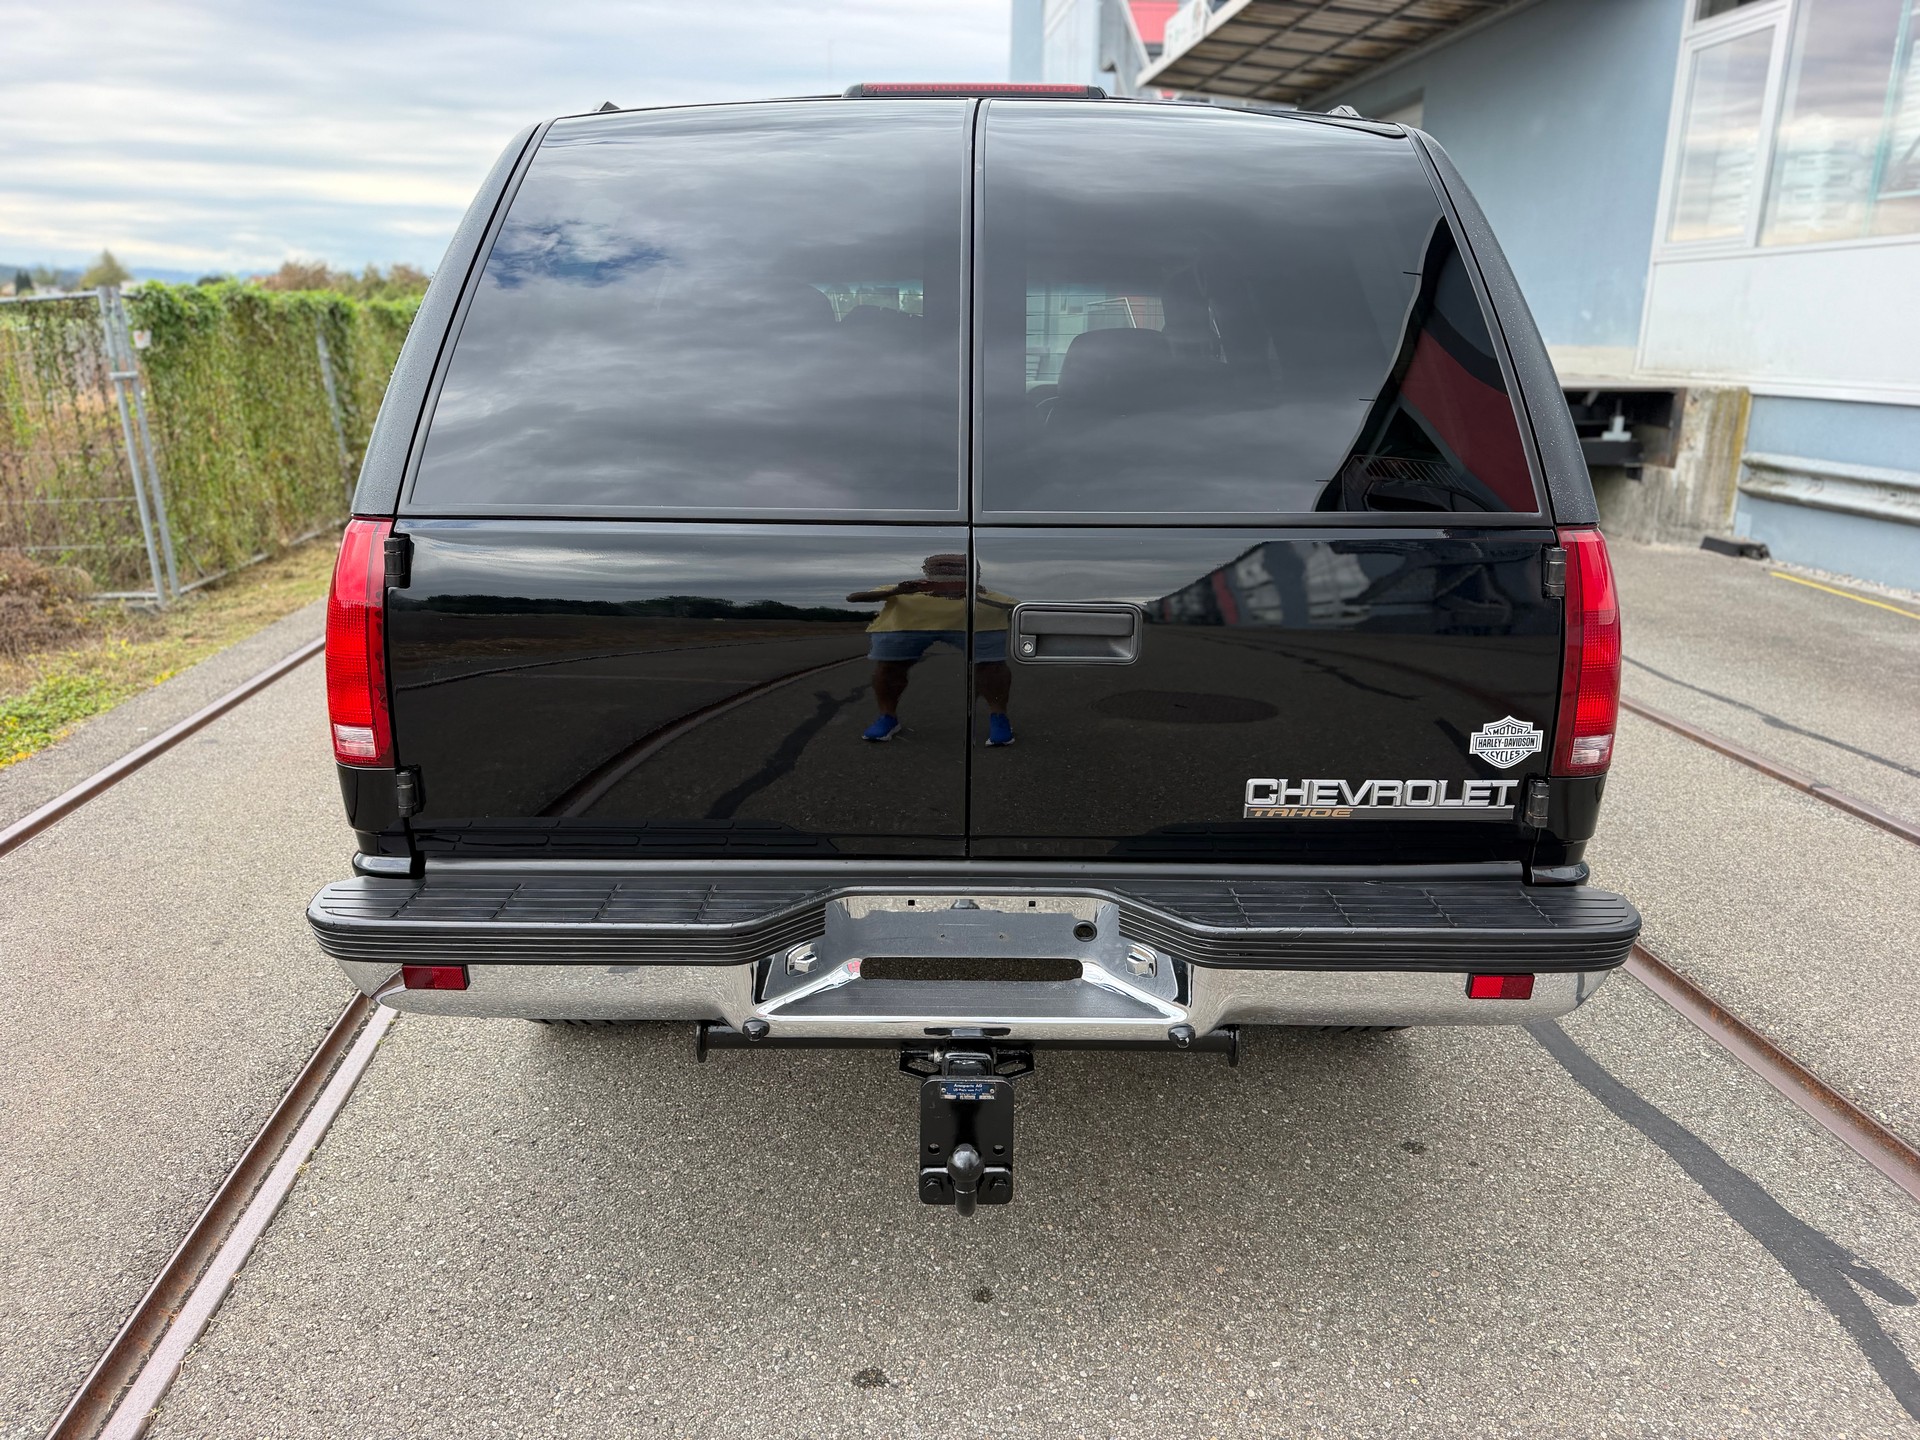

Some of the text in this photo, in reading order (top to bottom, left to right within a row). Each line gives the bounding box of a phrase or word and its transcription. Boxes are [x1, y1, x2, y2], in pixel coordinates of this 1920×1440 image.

[1493, 725, 1523, 735] MOTOR
[1478, 738, 1535, 748] HARLEY-DAVIDSON
[1491, 750, 1520, 762] CYCLES
[1245, 778, 1519, 806] CHEVROLET
[1250, 808, 1353, 817] TAHOE
